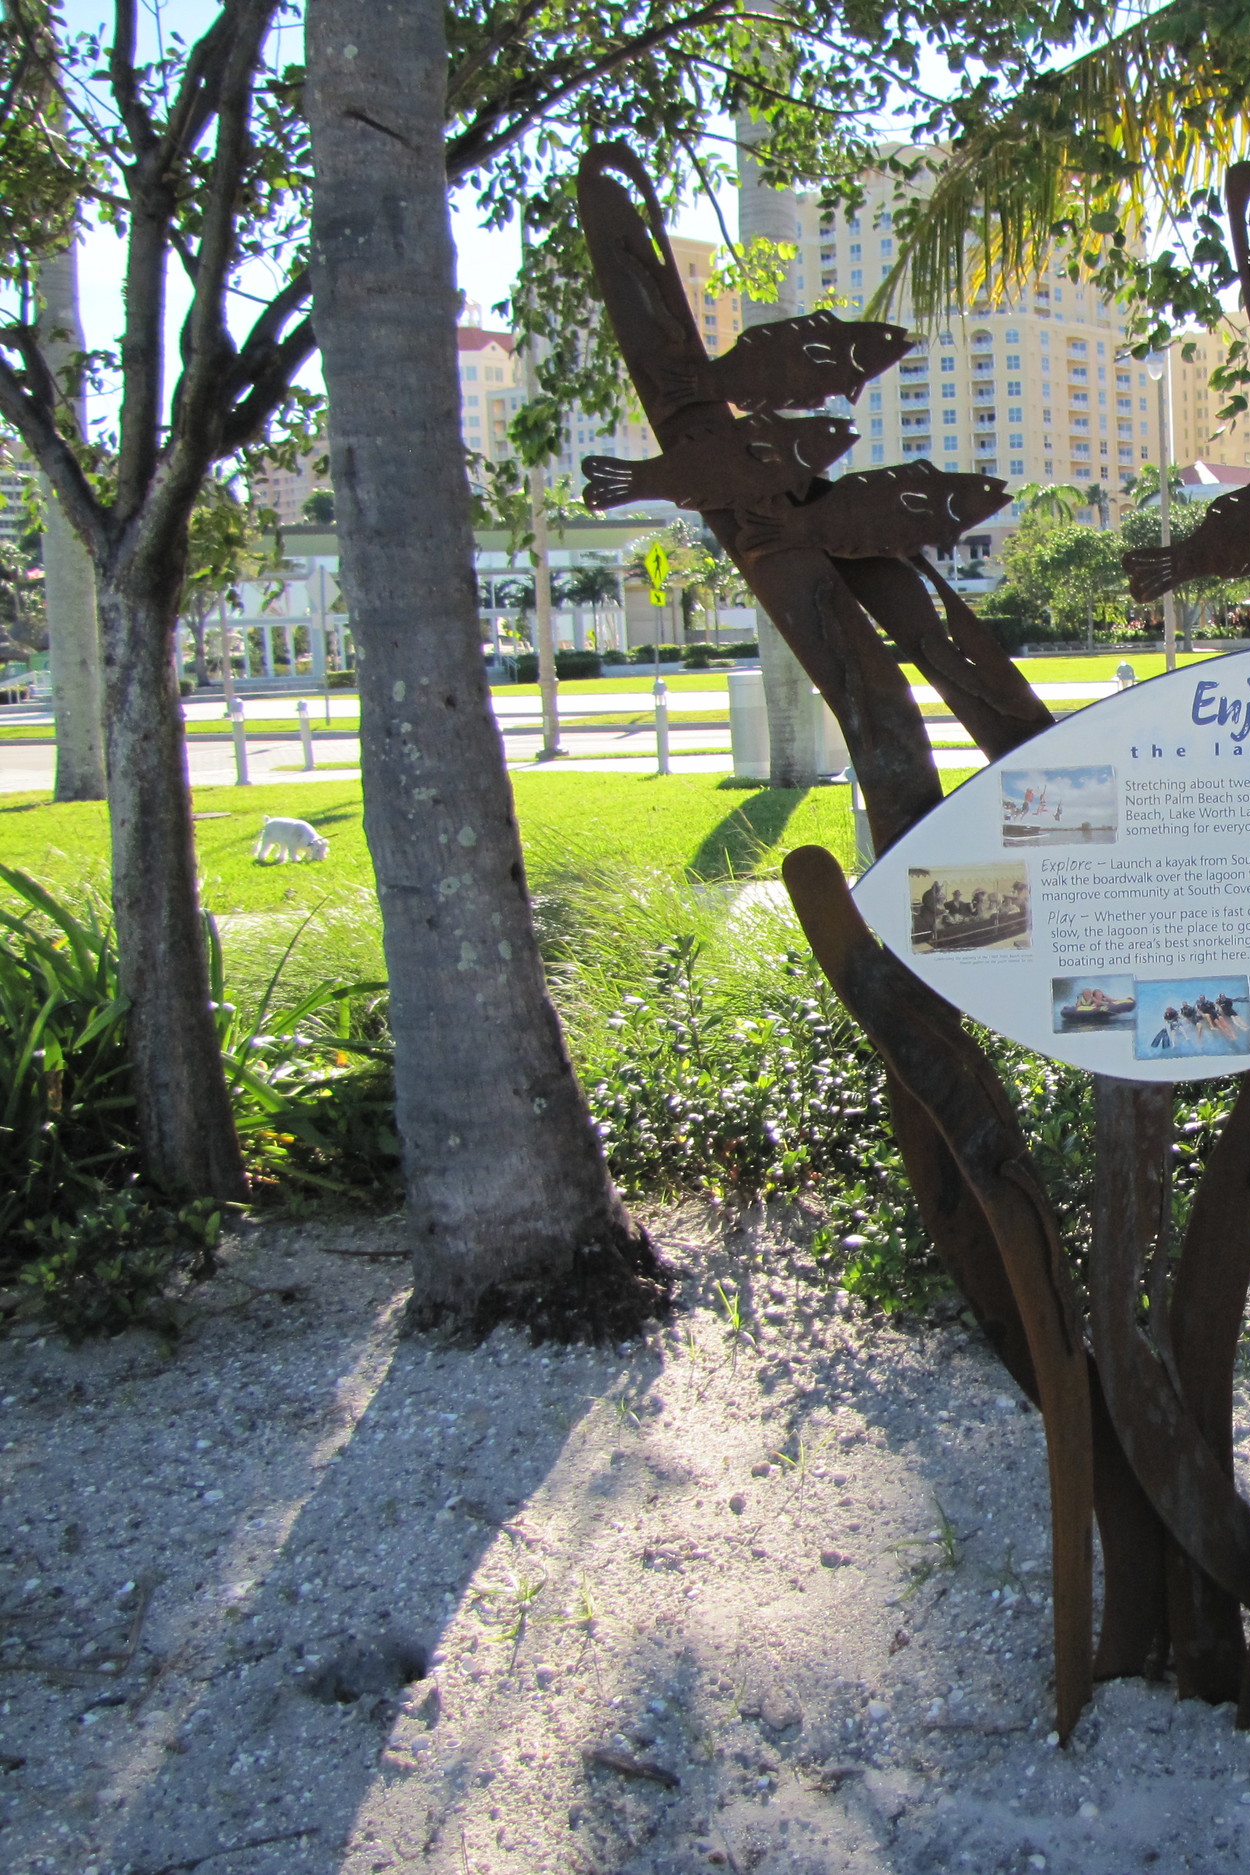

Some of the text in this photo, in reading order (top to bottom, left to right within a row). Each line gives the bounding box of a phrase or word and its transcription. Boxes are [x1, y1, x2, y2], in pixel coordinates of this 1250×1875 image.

[1130, 744, 1186, 758] the
[1125, 778, 1186, 793] Stretching
[1190, 778, 1224, 790] about
[1126, 794, 1160, 806] North
[1165, 793, 1194, 805] Palm
[1198, 792, 1233, 804] Beach
[1126, 809, 1164, 822] Beach,
[1169, 808, 1195, 820] Lake
[1199, 806, 1236, 818] Worth
[1126, 824, 1189, 837] something
[1194, 823, 1209, 834] for
[1041, 857, 1093, 875] Explore
[1110, 857, 1152, 870] Launch
[1155, 859, 1162, 868] a
[1166, 856, 1197, 870] kayak
[1200, 855, 1228, 866] from
[1041, 874, 1068, 887] walk
[1071, 874, 1090, 886] the
[1094, 872, 1152, 885] boardwalk
[1156, 873, 1181, 883] over
[1184, 870, 1203, 881] the
[1206, 870, 1245, 884] lagoon
[1042, 891, 1100, 904] mangrove
[1104, 886, 1170, 900] community
[1173, 886, 1184, 897] at
[1188, 884, 1221, 896] South
[1048, 910, 1076, 927] Play
[1094, 910, 1146, 922] Whether
[1149, 911, 1176, 923] your
[1180, 909, 1208, 922] pace
[1211, 907, 1220, 918] is
[1223, 906, 1244, 917] fast
[1051, 927, 1080, 939] slow,
[1084, 926, 1104, 937] the
[1107, 925, 1148, 939] lagoon
[1152, 924, 1160, 934] is
[1164, 922, 1183, 934] the
[1187, 922, 1218, 936] place
[1222, 922, 1234, 932] to
[1052, 941, 1086, 953] Some
[1089, 940, 1102, 951] of
[1105, 940, 1124, 951] the
[1128, 938, 1161, 950] area's
[1165, 938, 1189, 948] best
[1058, 949, 1250, 969] boating and fishing is right here.
